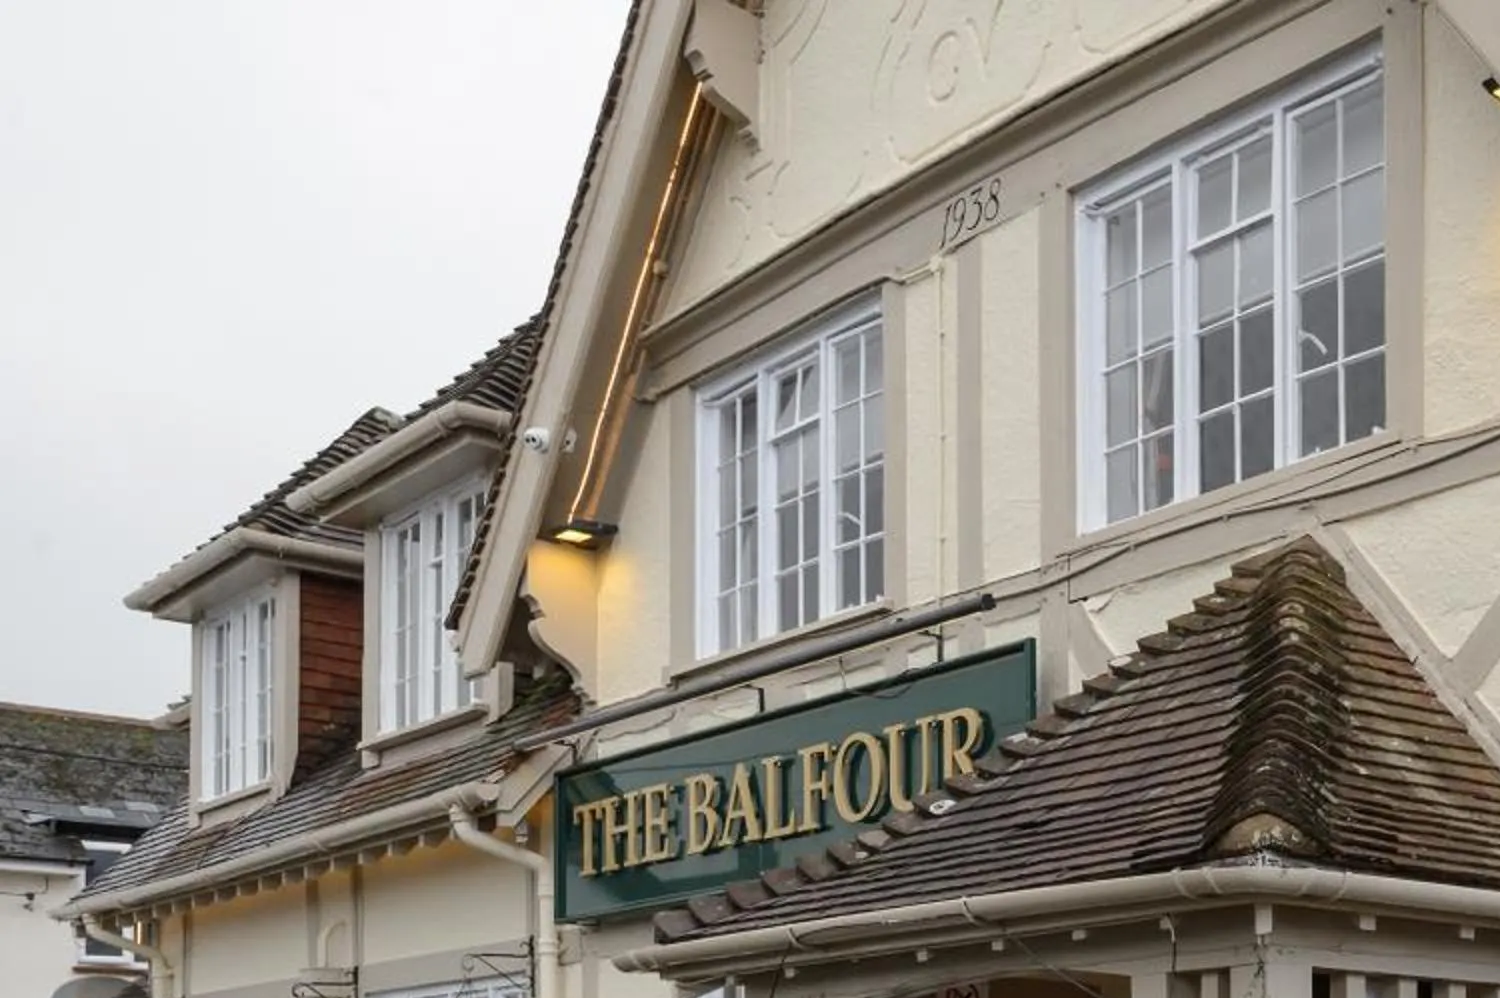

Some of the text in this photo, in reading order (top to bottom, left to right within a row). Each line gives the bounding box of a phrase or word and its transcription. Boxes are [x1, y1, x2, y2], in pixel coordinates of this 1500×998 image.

[939, 178, 1001, 250] 1938
[573, 707, 984, 878] THE BALFOUR
